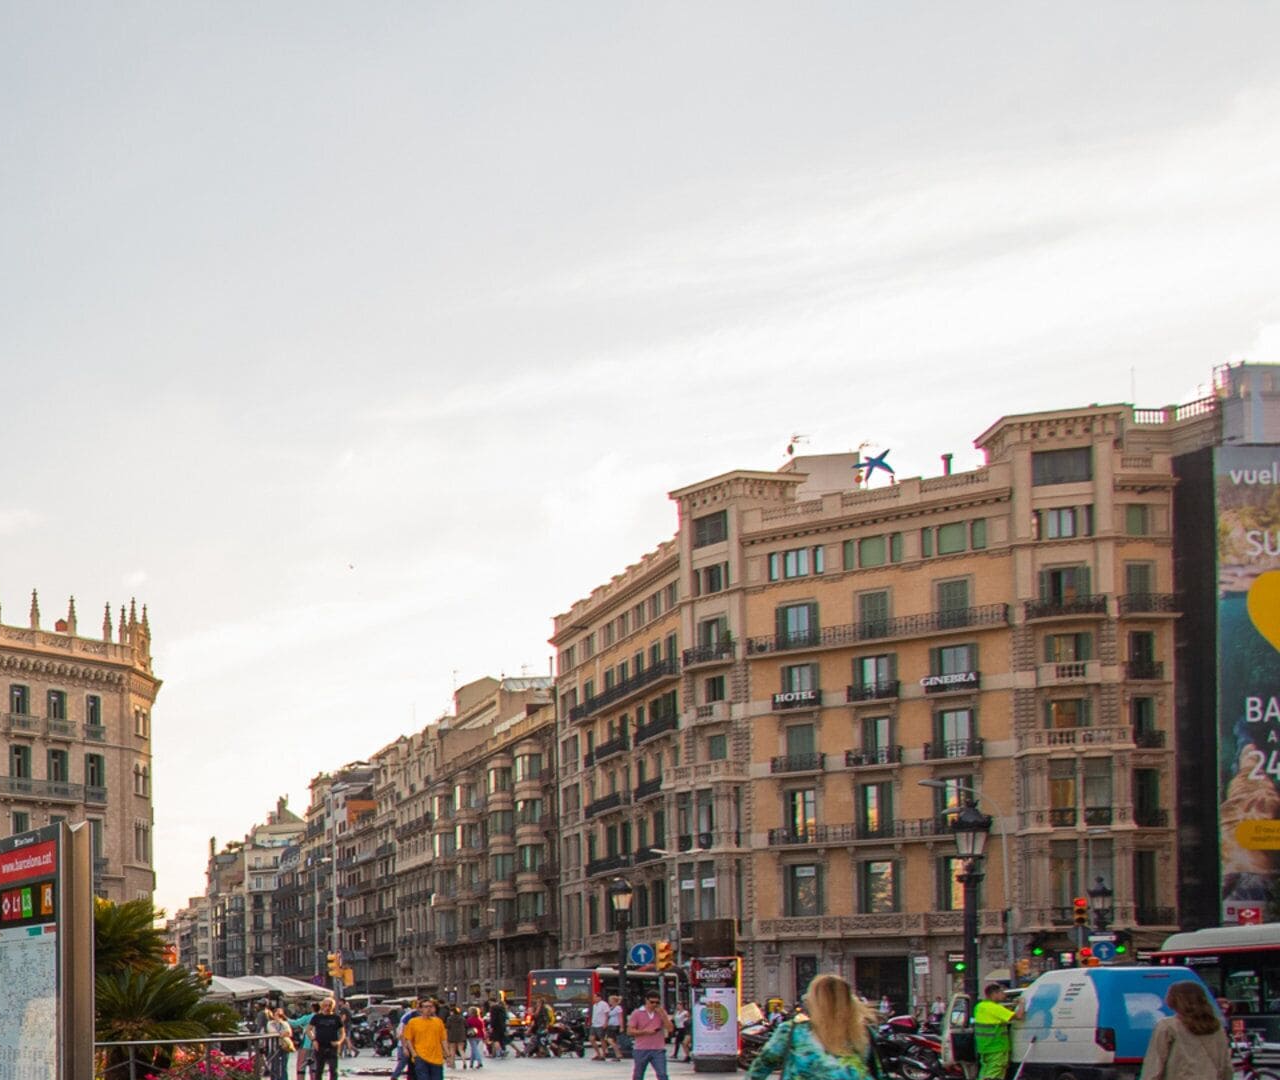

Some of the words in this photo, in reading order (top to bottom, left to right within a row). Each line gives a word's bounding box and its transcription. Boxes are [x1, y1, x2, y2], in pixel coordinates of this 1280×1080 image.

[1230, 462, 1280, 485] vuel
[775, 690, 815, 703] HOTEL
[919, 672, 976, 686] GINEBRA
